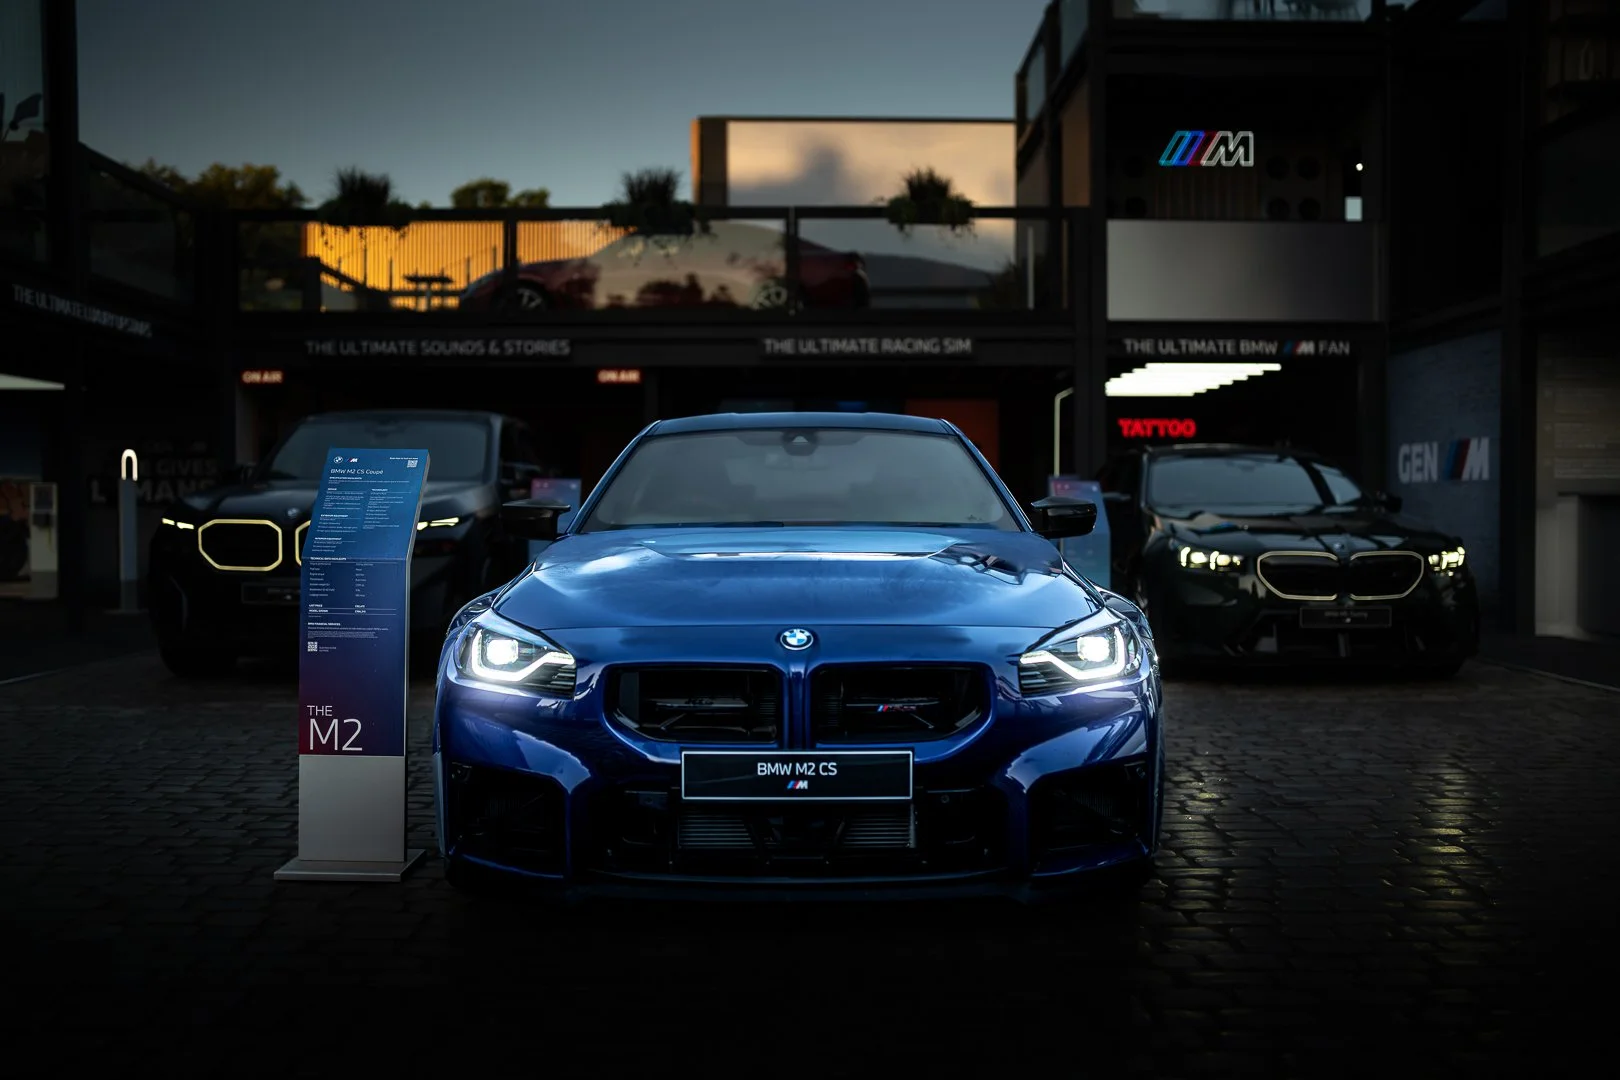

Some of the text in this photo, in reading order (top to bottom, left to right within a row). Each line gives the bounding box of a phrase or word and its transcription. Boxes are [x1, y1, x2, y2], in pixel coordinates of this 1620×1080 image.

[1200, 130, 1255, 167] M
[304, 339, 571, 357] THE ULTIMATE SOUNDS & STORIES
[763, 337, 973, 355] THE ULTIMATE RACING SIM
[1123, 338, 1350, 356] THE ULTIMATE BMW M FAN
[241, 370, 283, 384] ON AIR
[598, 369, 641, 384] ON AIR
[1116, 417, 1197, 439] TATTOO
[1398, 436, 1491, 484] GEN M
[307, 705, 333, 717] THE
[309, 718, 363, 752] M2
[757, 762, 838, 776] BMW M2 CS
